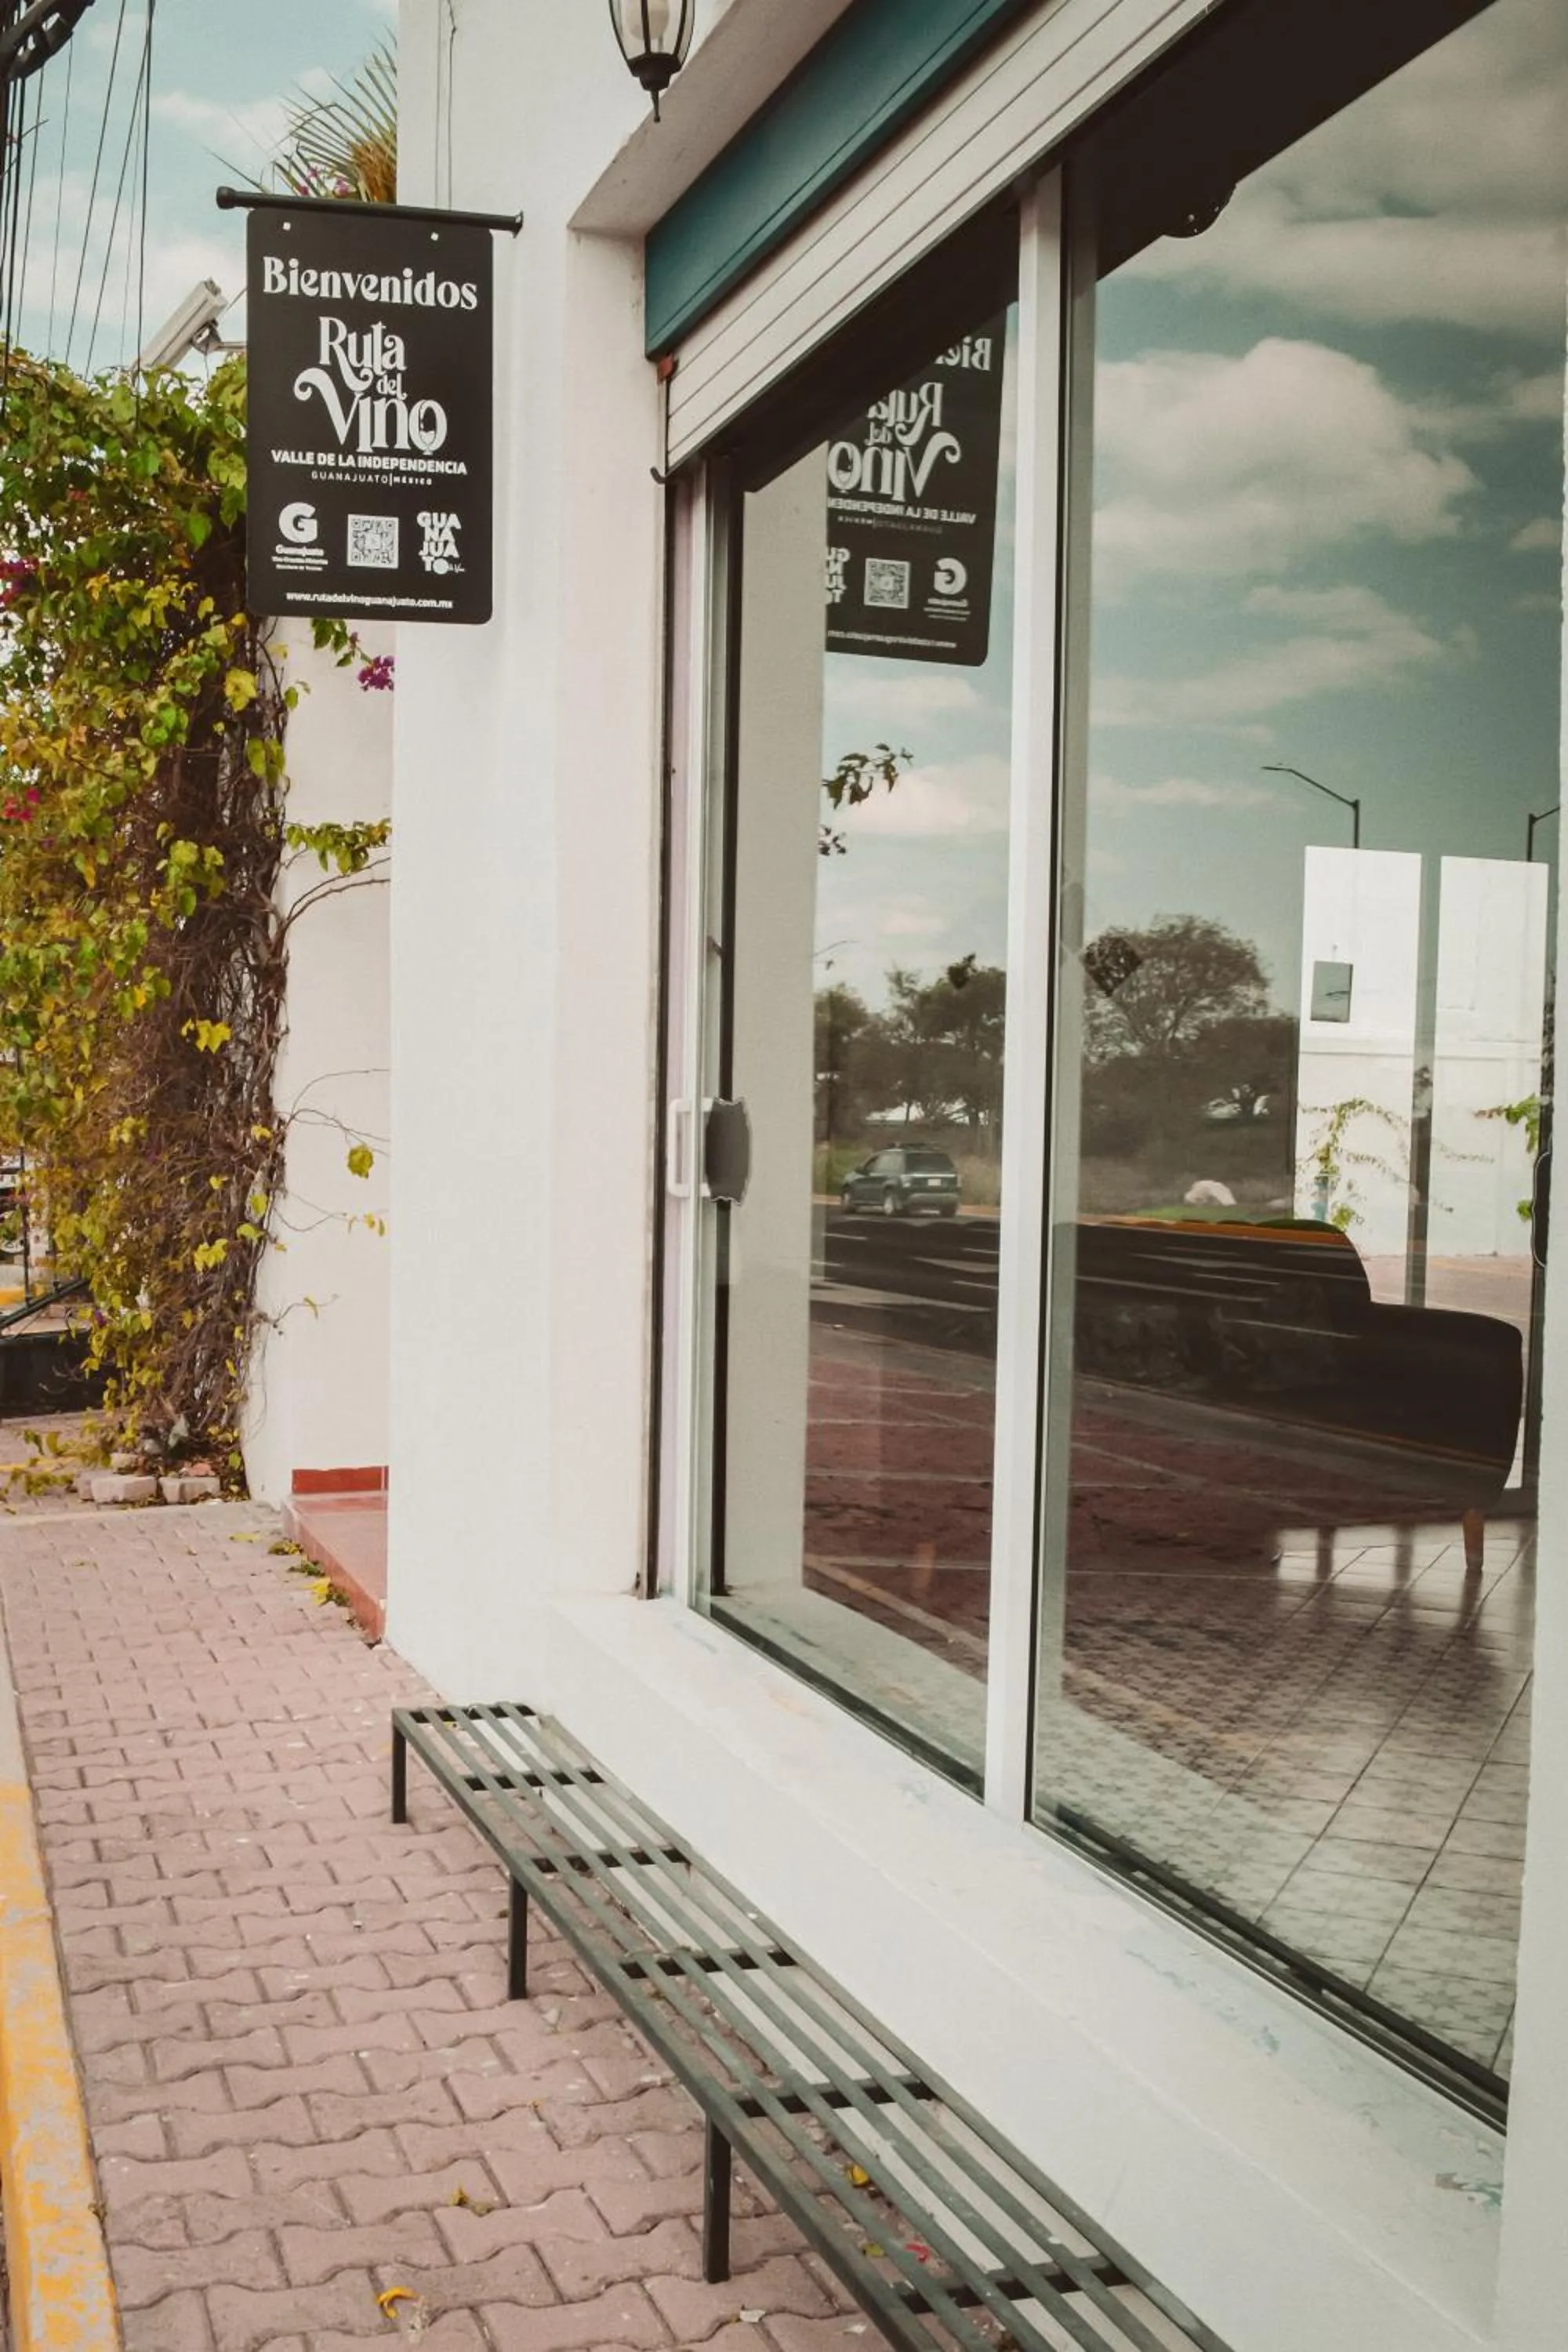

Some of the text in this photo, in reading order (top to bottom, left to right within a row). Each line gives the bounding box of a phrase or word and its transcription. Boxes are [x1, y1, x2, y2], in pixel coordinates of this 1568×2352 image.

[263, 256, 477, 310] Bienvenidos
[319, 316, 408, 392] Ruta
[376, 372, 408, 400] del
[294, 367, 448, 455] Vino
[271, 449, 467, 475] VALLE DE LA INDEPENDENCIA
[279, 503, 318, 543] G
